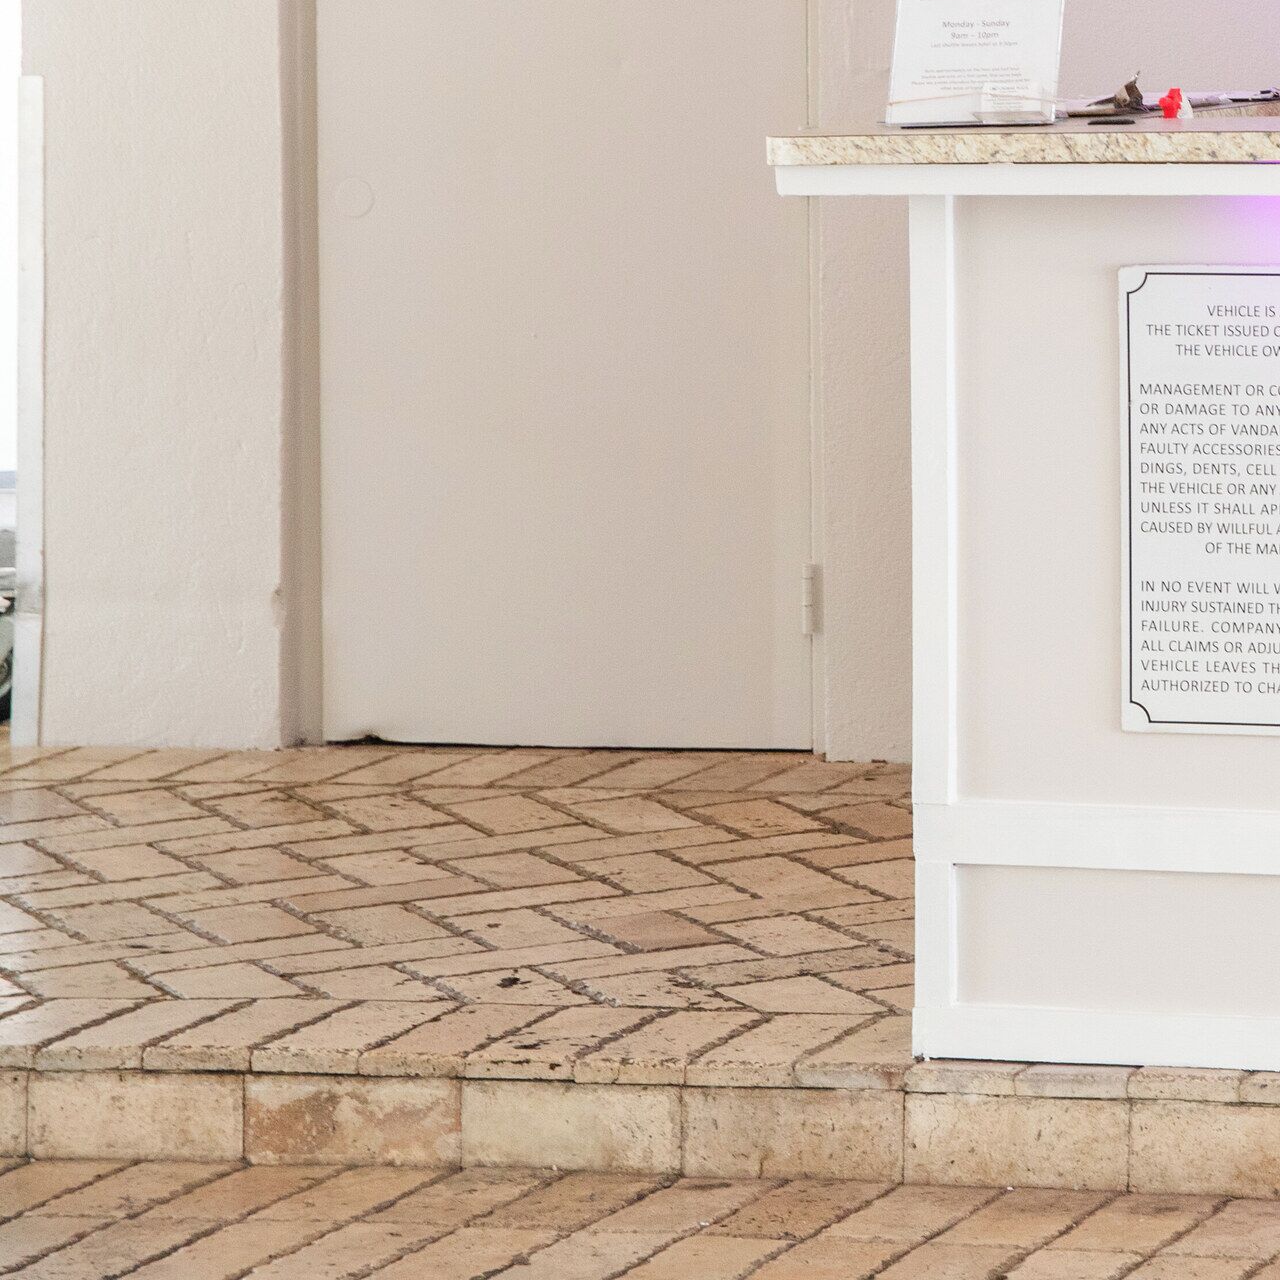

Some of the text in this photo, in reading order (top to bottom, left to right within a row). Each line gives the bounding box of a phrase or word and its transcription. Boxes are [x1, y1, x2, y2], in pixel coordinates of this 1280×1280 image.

[1206, 304, 1261, 318] VEHICLE
[1264, 304, 1276, 318] IS
[1145, 323, 1172, 337] THE
[1174, 323, 1220, 337] TICKET
[1223, 324, 1270, 338] ISSUED
[1174, 343, 1201, 357] THE
[1204, 343, 1258, 357] VEHICLE
[1139, 382, 1242, 396] MANAGEMENT
[1244, 383, 1265, 397] OR
[1139, 441, 1189, 455] FAULTY
[1245, 462, 1277, 476] CELL
[1140, 501, 1192, 514] UNLESS
[1196, 501, 1209, 514] IT
[1213, 501, 1256, 515] SHALL
[1140, 520, 1193, 534] CAUSED
[1196, 521, 1213, 534] BY
[1216, 522, 1273, 536] WILLFUL
[1204, 541, 1223, 554] OF
[1225, 541, 1252, 555] THE
[1140, 599, 1187, 613] INJURY
[1190, 600, 1264, 614] SUSTAINED
[1140, 658, 1199, 673] VEHICLE
[1205, 660, 1257, 674] LEAVES
[1140, 678, 1230, 693] AUTHORIZED
[1233, 680, 1253, 694] TO
